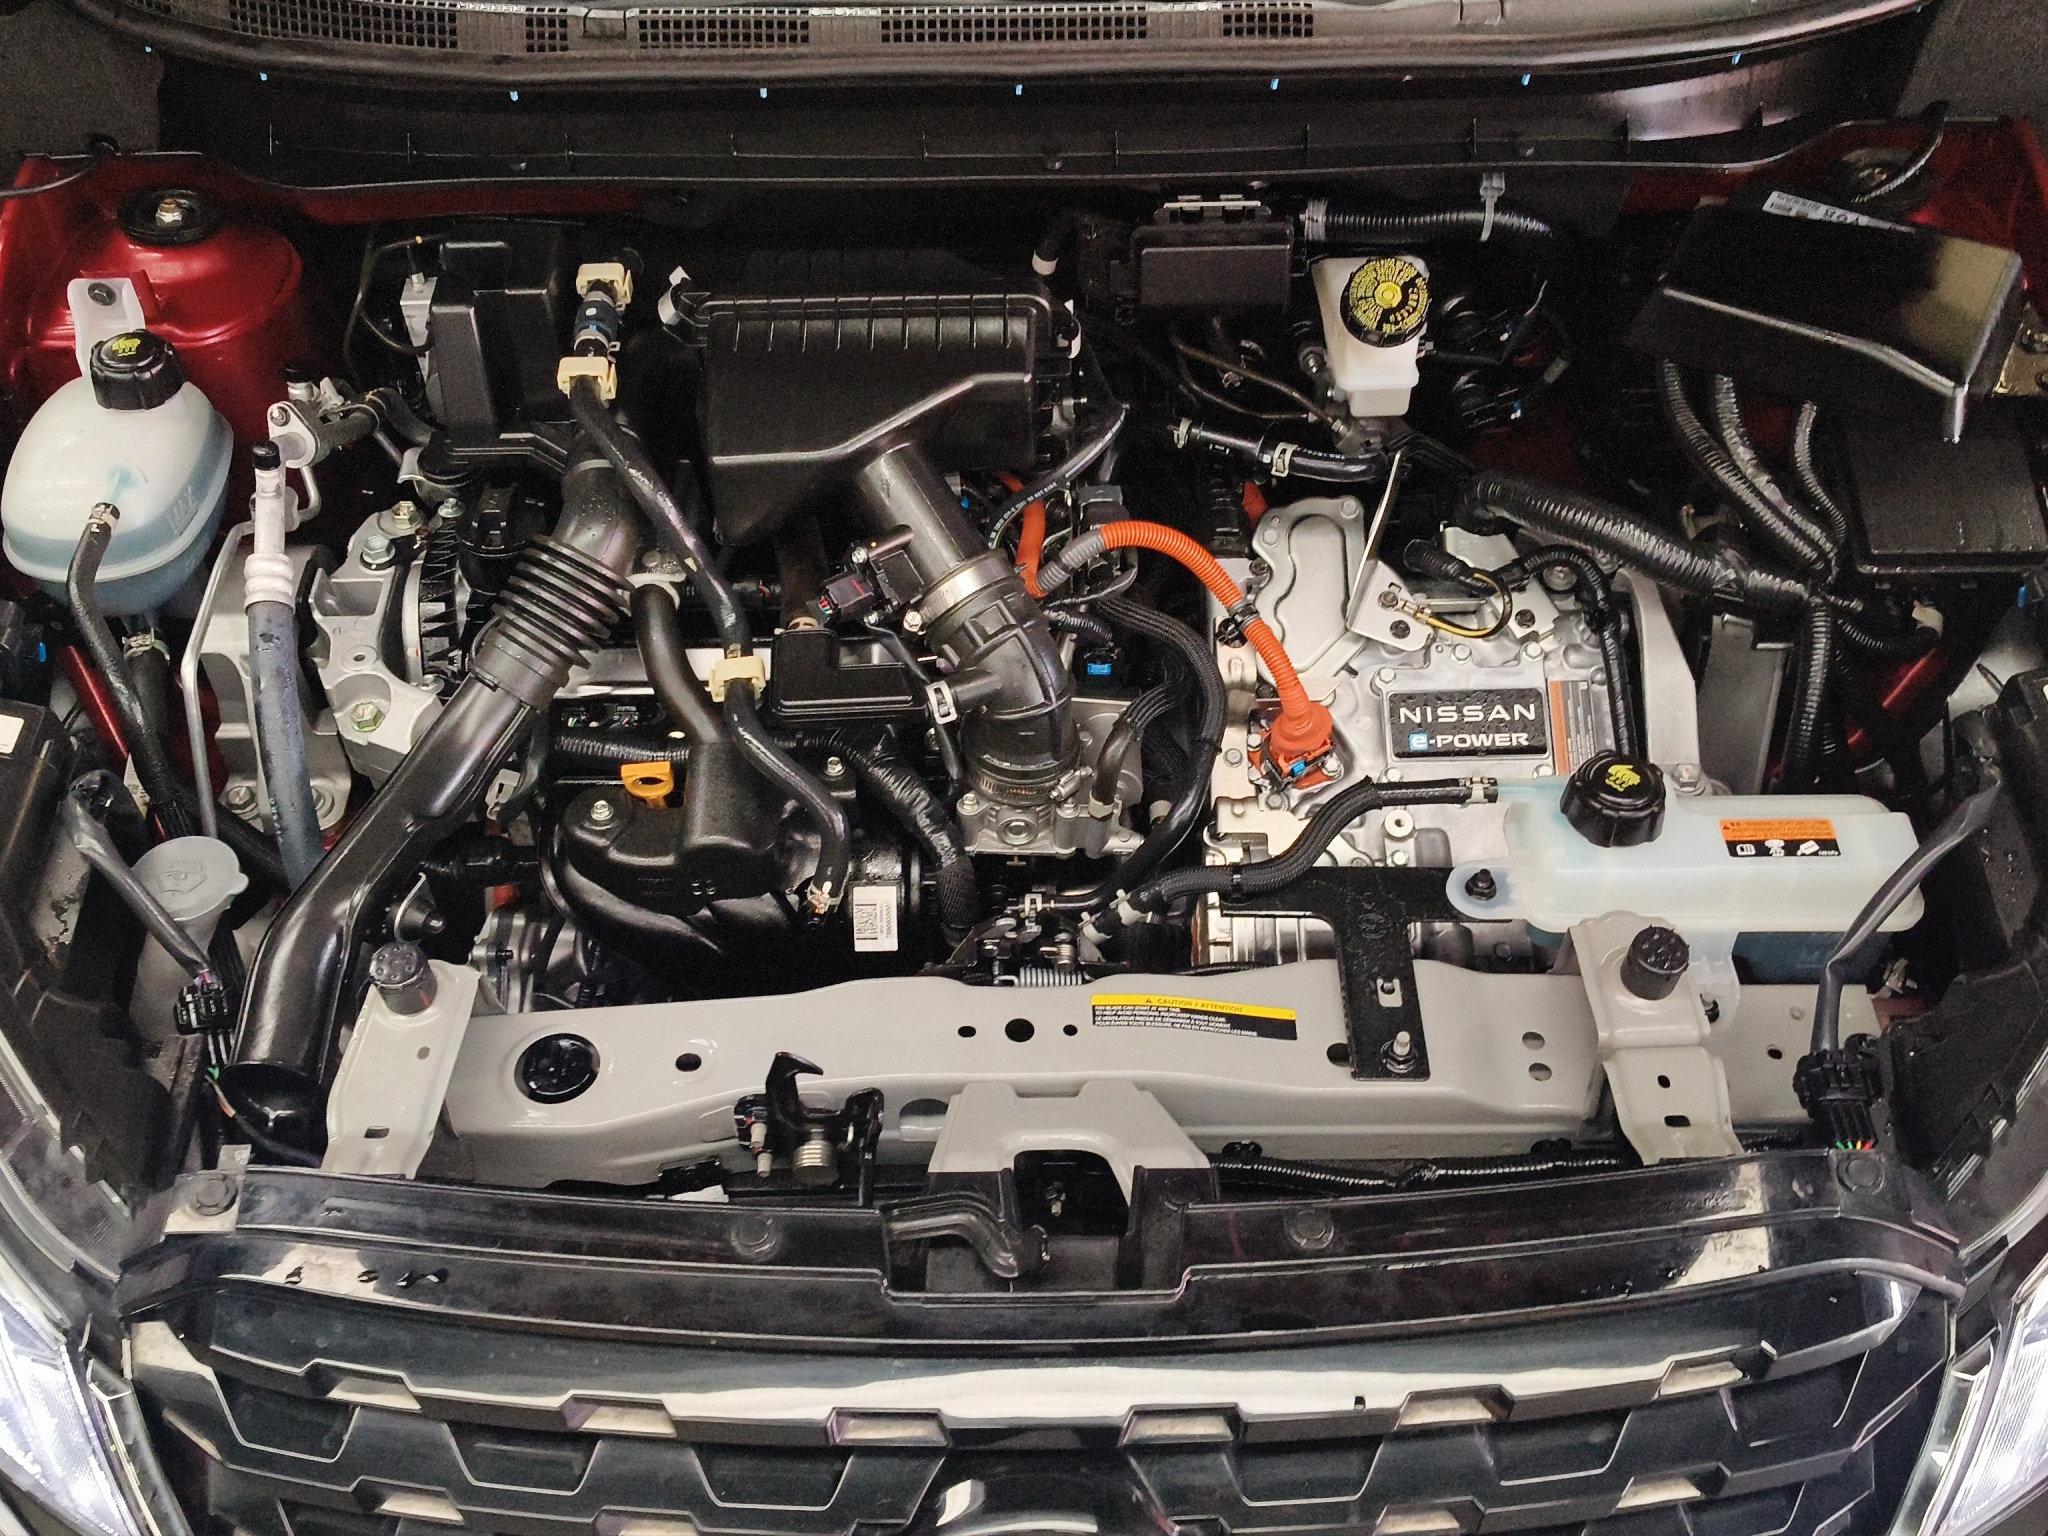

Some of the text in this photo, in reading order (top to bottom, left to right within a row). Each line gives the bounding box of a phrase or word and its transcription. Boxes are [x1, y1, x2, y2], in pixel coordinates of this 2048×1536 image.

[1400, 703, 1536, 724] NISSAN
[1409, 733, 1530, 749] e-POWER
[1157, 998, 1193, 1006] CAUTION
[1200, 1002, 1243, 1013] ATTENTION
